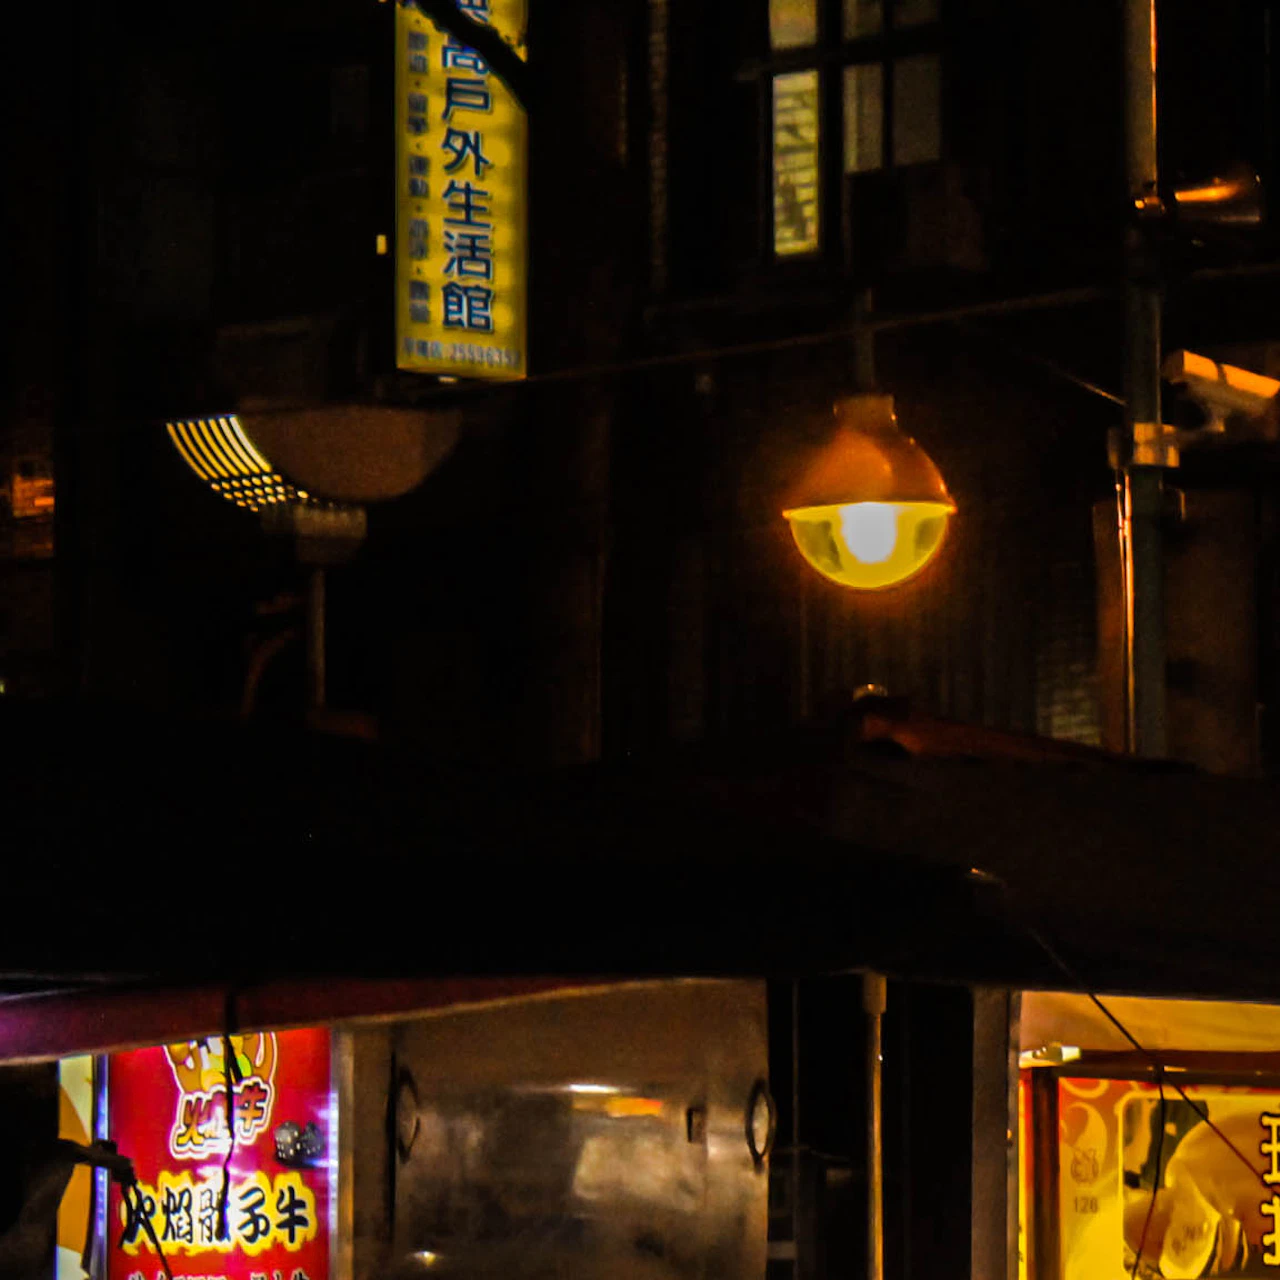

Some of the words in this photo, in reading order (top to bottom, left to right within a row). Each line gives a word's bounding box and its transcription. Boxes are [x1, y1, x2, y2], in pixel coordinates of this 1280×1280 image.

[441, 0, 494, 332] 戶外生活館
